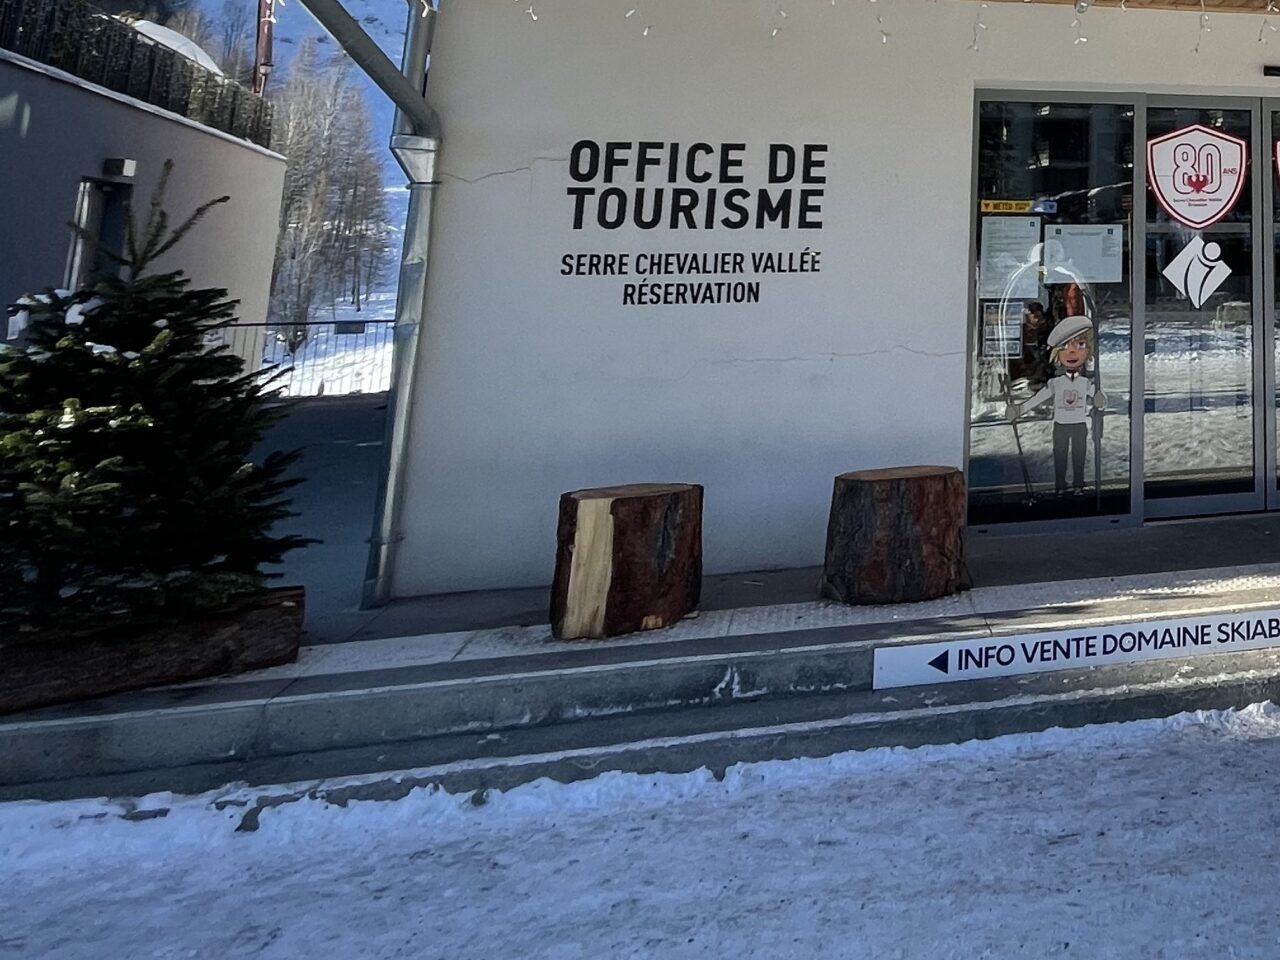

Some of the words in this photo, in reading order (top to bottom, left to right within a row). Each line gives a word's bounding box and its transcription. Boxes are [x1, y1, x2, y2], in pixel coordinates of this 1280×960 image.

[568, 140, 747, 184] OFFICE
[768, 143, 829, 185] DE
[1173, 143, 1222, 195] 80
[567, 187, 825, 230] TOURISME
[560, 253, 630, 276] SERRE
[635, 252, 745, 276] CHEVALIER
[751, 247, 821, 274] VALLÉE
[623, 278, 761, 306] RÉSERVATION
[957, 643, 1015, 671] INFO
[1022, 635, 1098, 665] VENTE
[1103, 625, 1213, 657] DOMAINE
